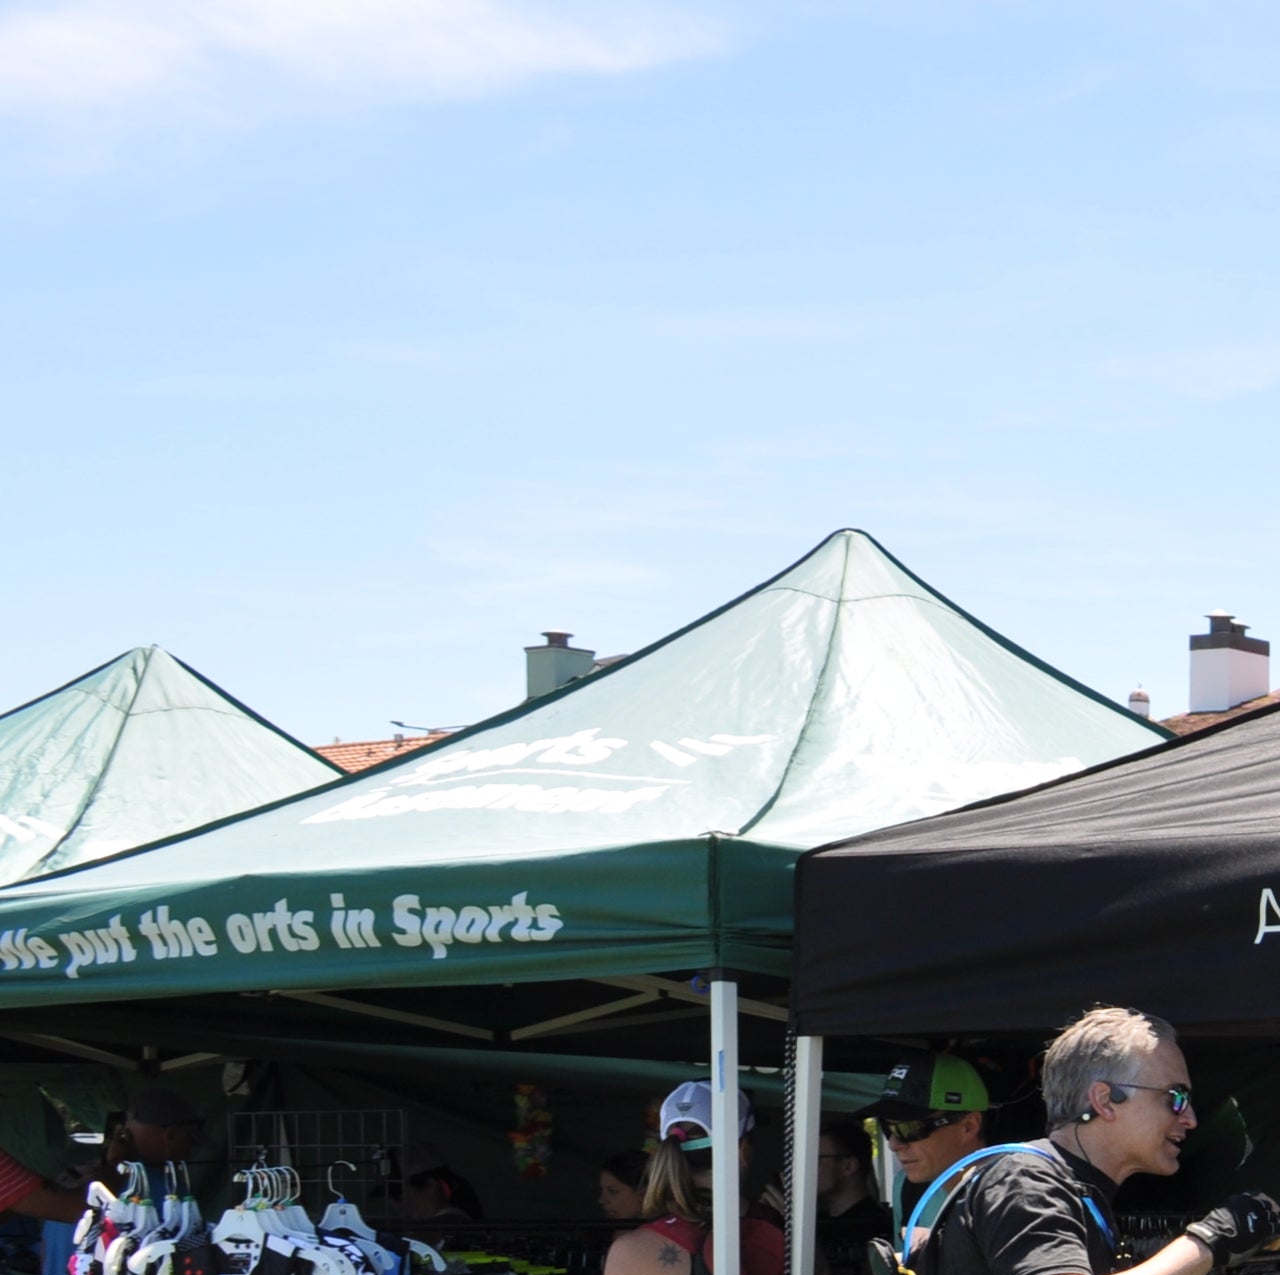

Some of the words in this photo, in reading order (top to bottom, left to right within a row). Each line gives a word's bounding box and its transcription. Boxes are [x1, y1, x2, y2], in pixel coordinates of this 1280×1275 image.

[59, 914, 137, 979] put
[138, 905, 218, 960] the
[330, 893, 382, 949] in
[391, 891, 564, 959] Sports
